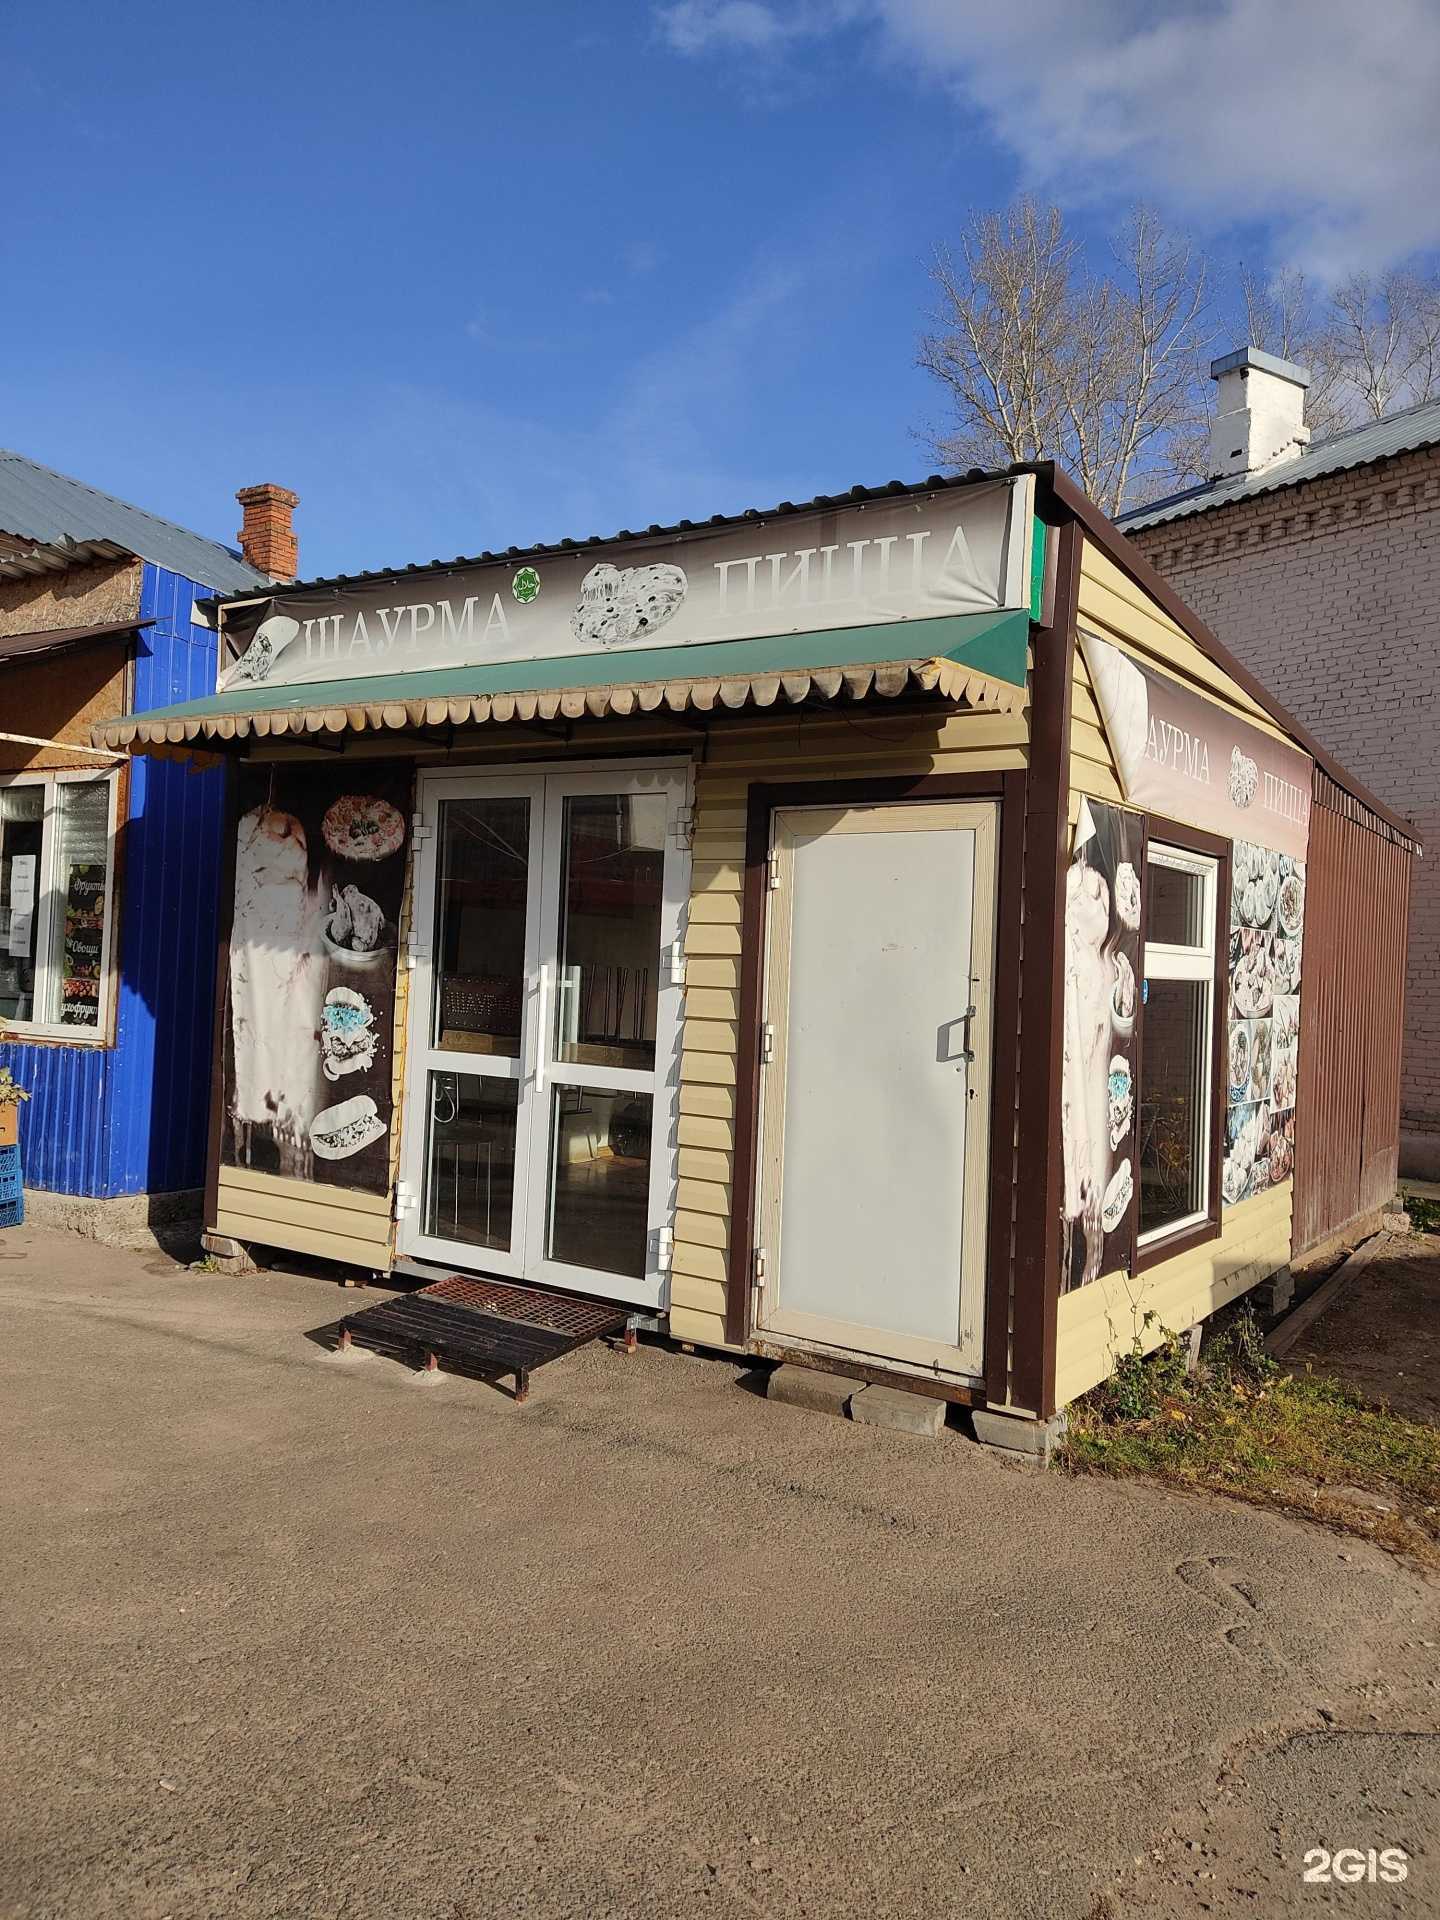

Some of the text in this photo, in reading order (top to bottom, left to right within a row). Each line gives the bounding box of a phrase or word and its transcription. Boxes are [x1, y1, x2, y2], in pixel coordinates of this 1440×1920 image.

[302, 525, 992, 662] ШАУРМА ПИЦЦА
[1144, 714, 1210, 785] АУРМА
[72, 940, 99, 956] Овощи
